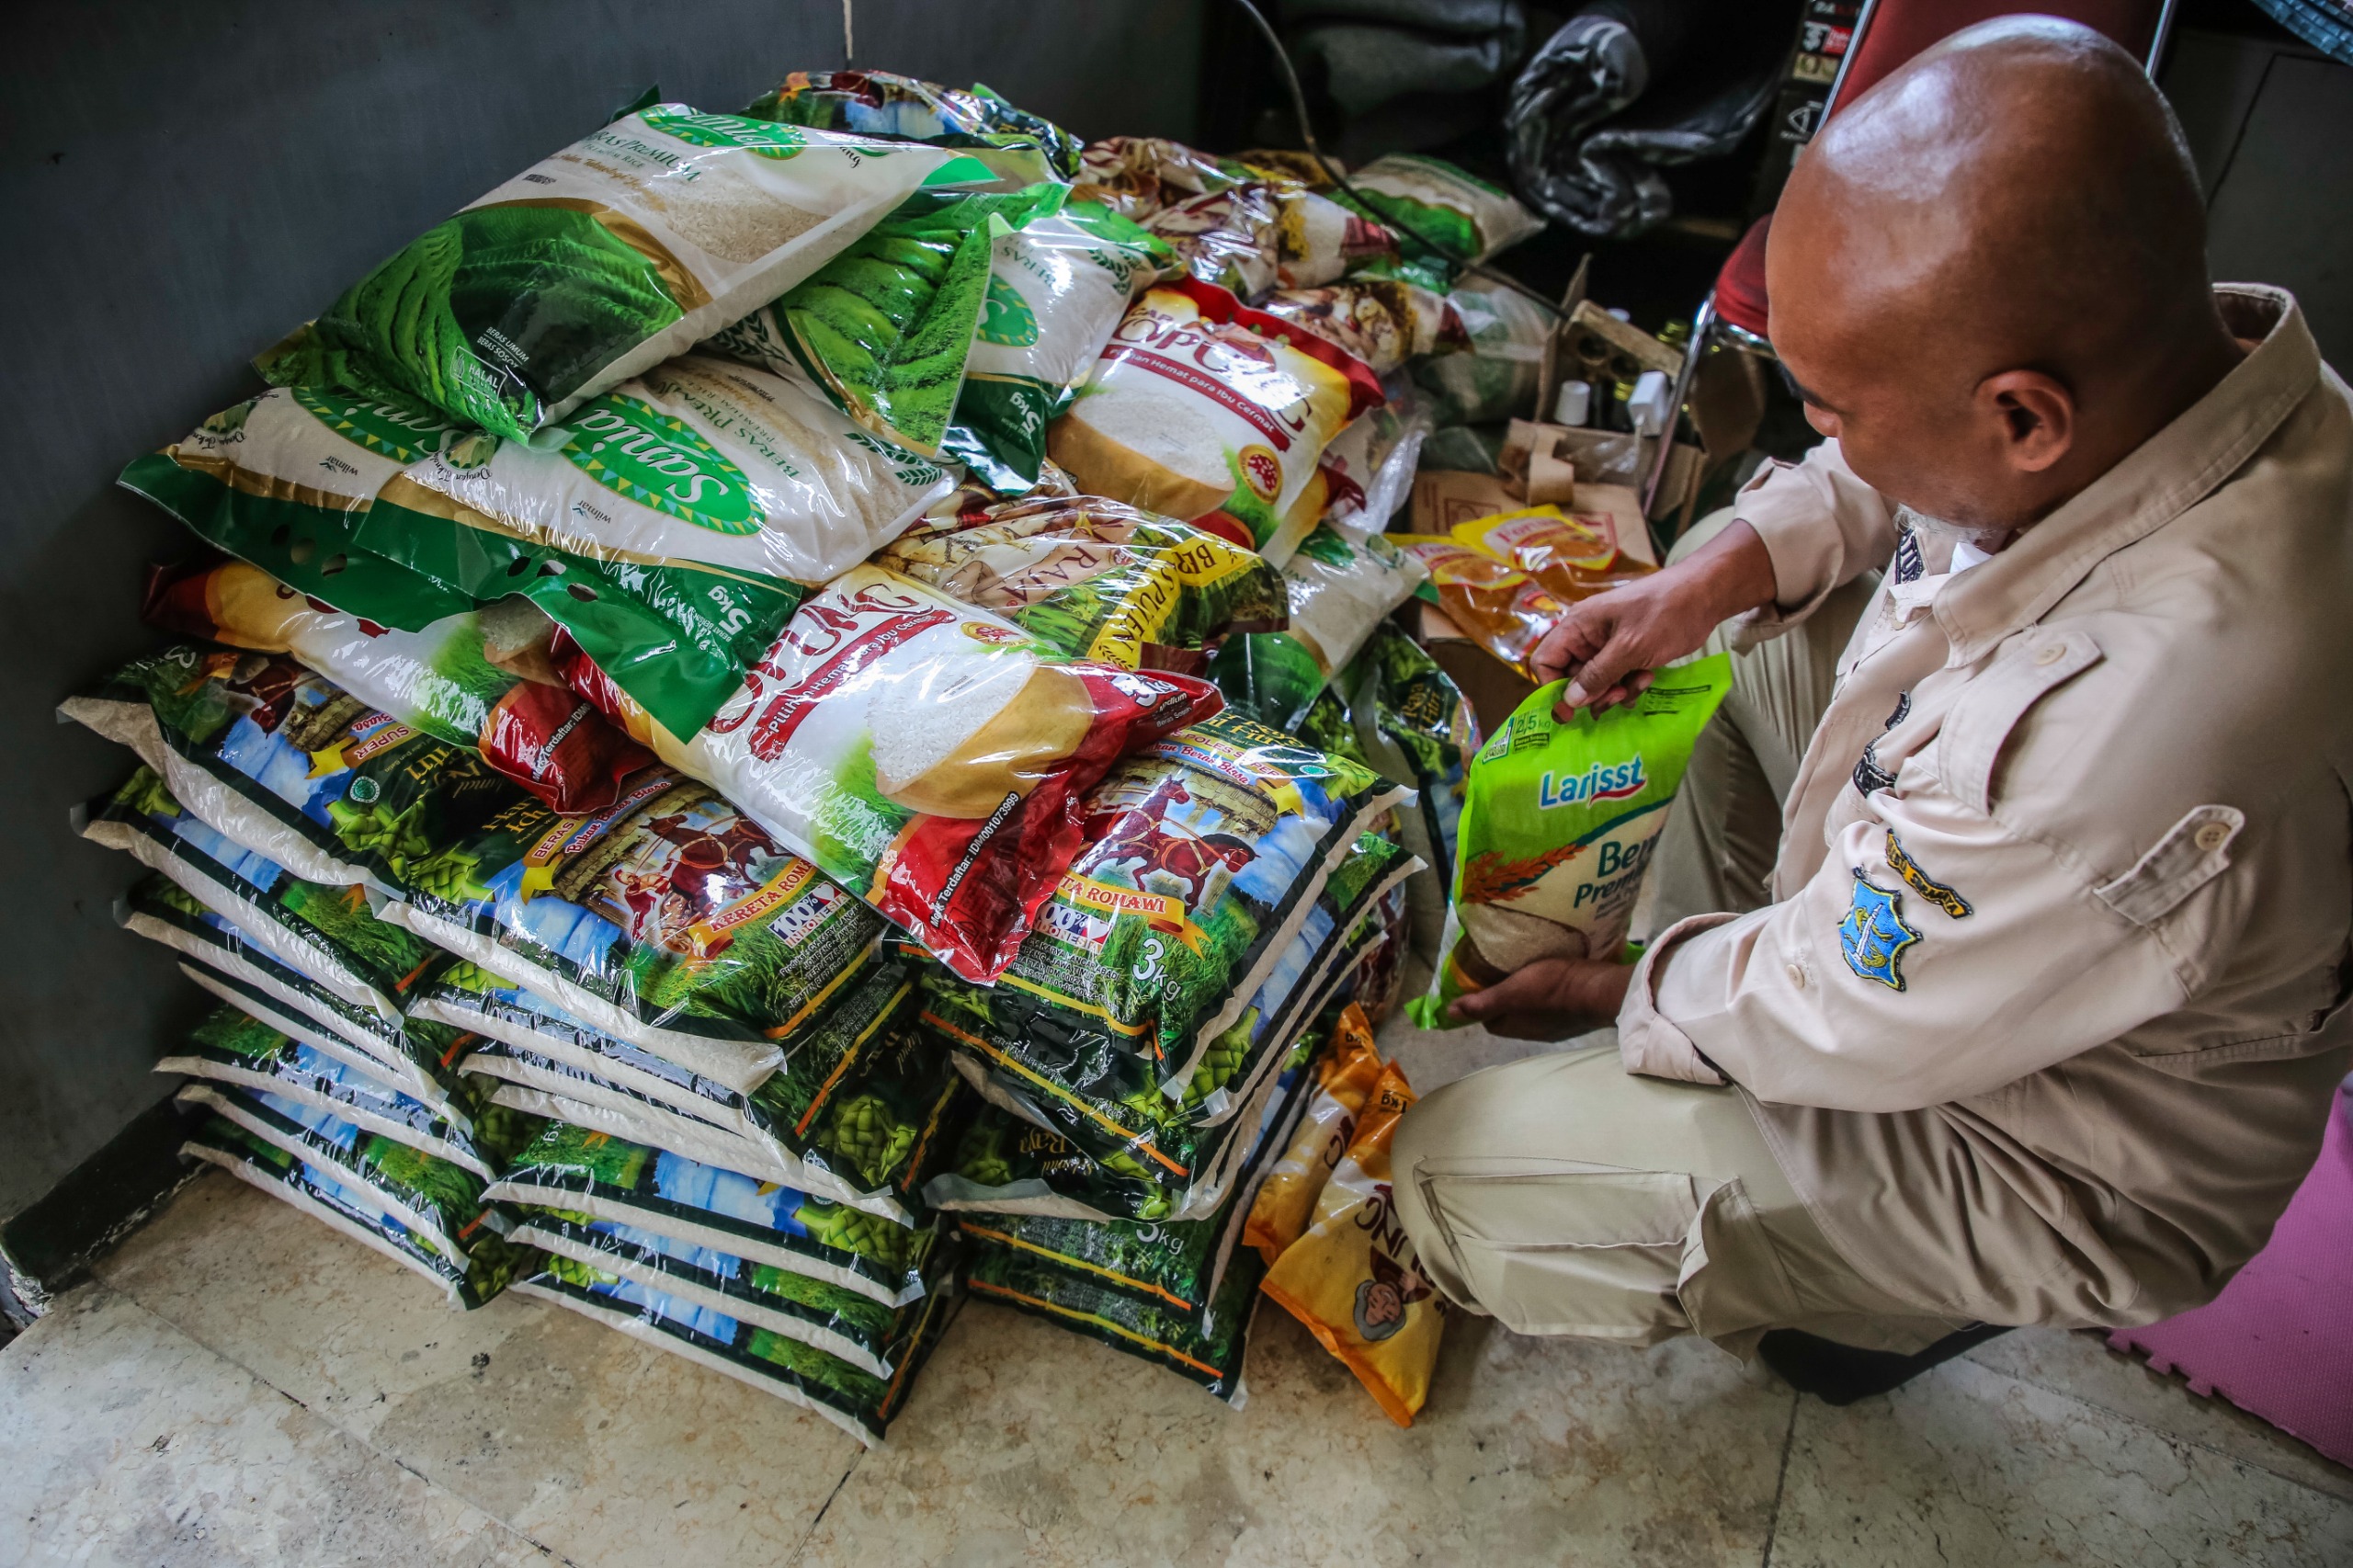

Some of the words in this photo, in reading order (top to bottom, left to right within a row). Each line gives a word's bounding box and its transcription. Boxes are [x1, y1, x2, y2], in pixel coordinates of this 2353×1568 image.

[684, 115, 779, 145] ania
[620, 140, 701, 181] PREMIUM
[622, 154, 645, 168] RICE
[477, 336, 494, 353] BERAS
[486, 326, 506, 343] BERAS
[505, 339, 530, 362] UMUM
[469, 363, 498, 388] HALAL
[1150, 358, 1189, 381] Hemat
[1188, 375, 1216, 392] para
[1216, 390, 1236, 404] Ibu
[1235, 401, 1276, 433] Cermat
[326, 455, 359, 476] wilmar
[572, 408, 729, 503] Sania
[734, 429, 801, 478] BERAS
[457, 469, 494, 482] Dengan
[578, 499, 612, 524] wilmar
[995, 545, 1101, 605] RAJA
[712, 626, 733, 642] BERAT
[352, 712, 393, 733] Biasa
[767, 685, 813, 734] Pilihan
[1156, 716, 1174, 727] Beras
[357, 725, 410, 760] SUPER
[1180, 744, 1216, 765] Beras
[1184, 733, 1233, 755] POLES
[1540, 755, 1645, 798] Larisst
[564, 822, 601, 854] Bukan
[597, 799, 632, 823] Beras
[630, 781, 672, 800] Biasa
[968, 791, 1020, 858] IDM001073999
[533, 821, 574, 859] BERAS
[937, 854, 974, 902] Terdaftar:
[711, 889, 783, 932] KERETA
[929, 902, 946, 928] Merk
[1086, 886, 1166, 915] ROMAWI
[774, 895, 819, 940] 100%
[787, 893, 849, 948] INDONESIA
[1040, 903, 1087, 932] 00%
[1040, 941, 1065, 959] KARYA
[1095, 967, 1120, 982] ABADI
[1046, 966, 1061, 978] IDM
[1051, 959, 1072, 972] JAWA
[1019, 1127, 1066, 1154] Raya
